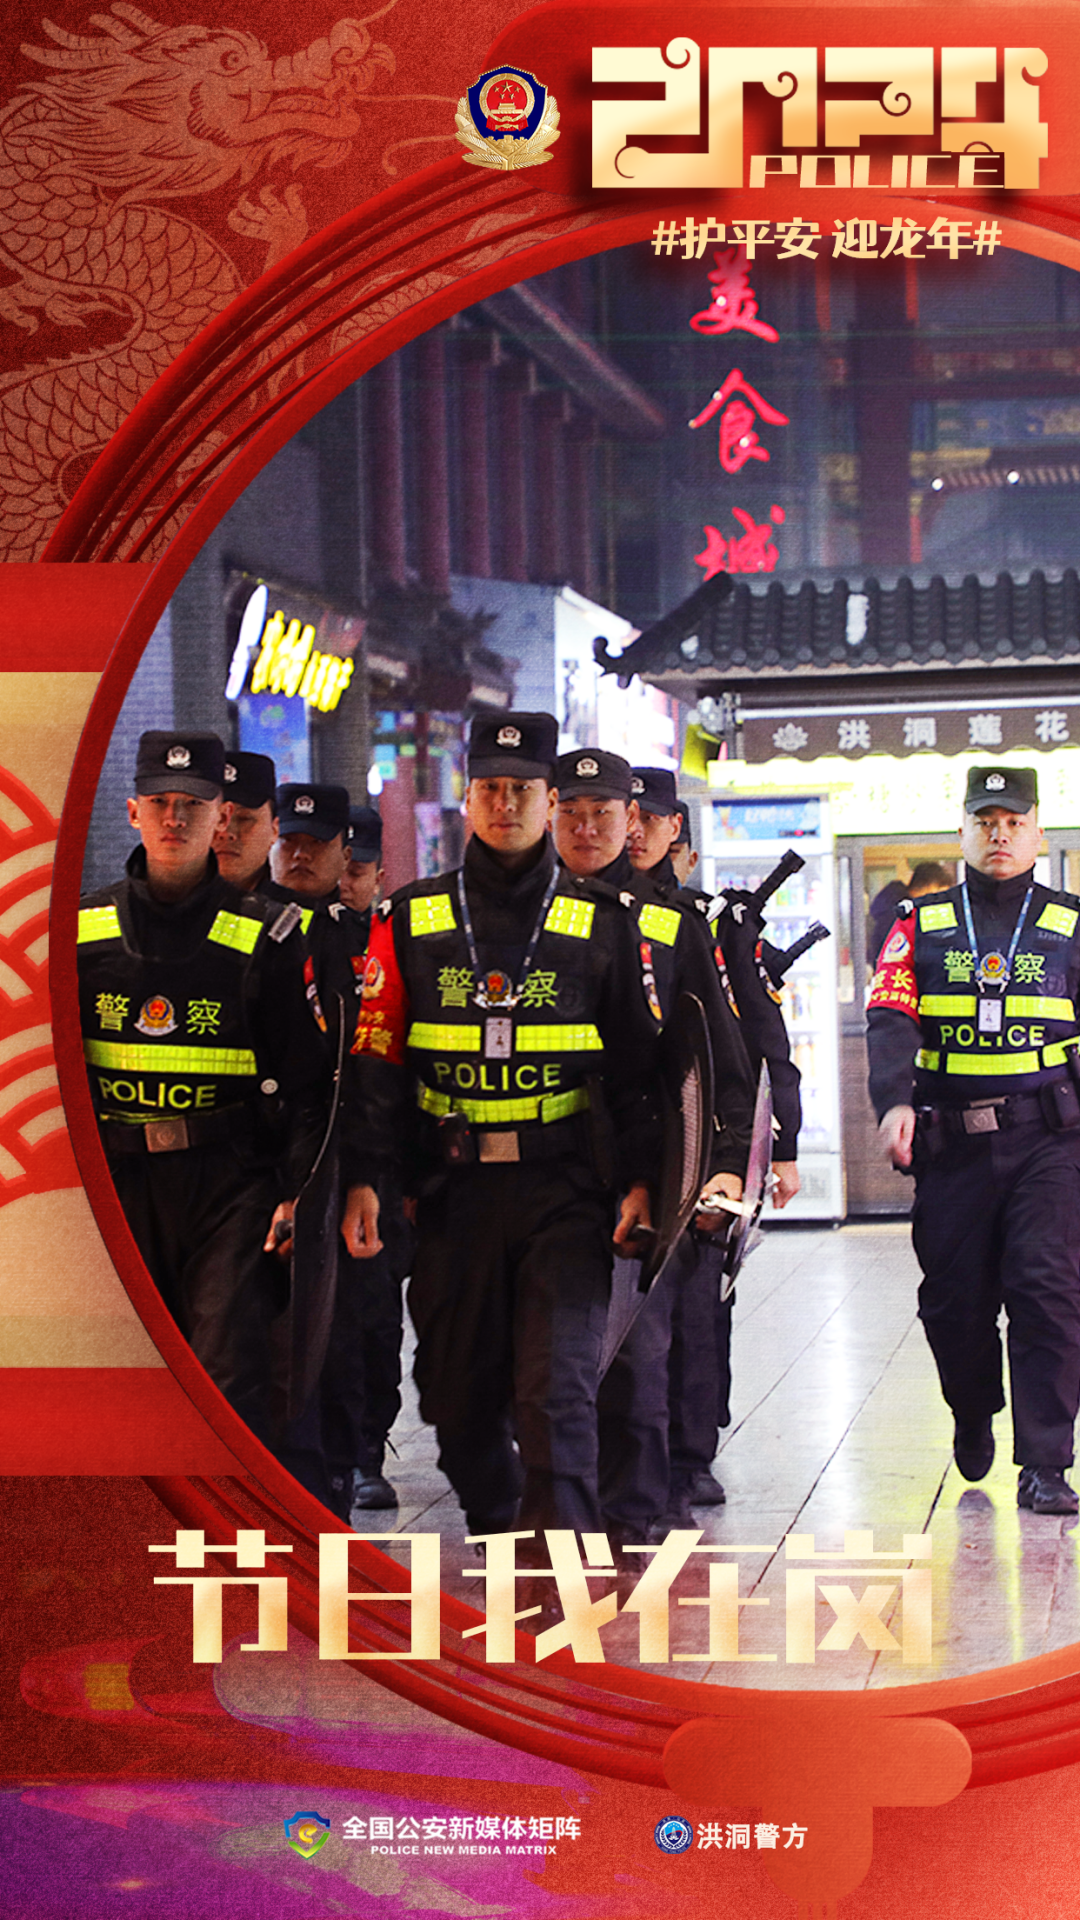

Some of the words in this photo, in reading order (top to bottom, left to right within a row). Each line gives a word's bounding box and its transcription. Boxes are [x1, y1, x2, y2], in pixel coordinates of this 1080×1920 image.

[689, 246, 790, 581] 美食城
[837, 710, 1070, 751] 洪洞莲花
[437, 966, 558, 1008] 警察
[943, 950, 1046, 984] 警察
[94, 992, 222, 1035] 警察
[97, 1076, 217, 1109] POLICE
[433, 1061, 562, 1091] POLICE
